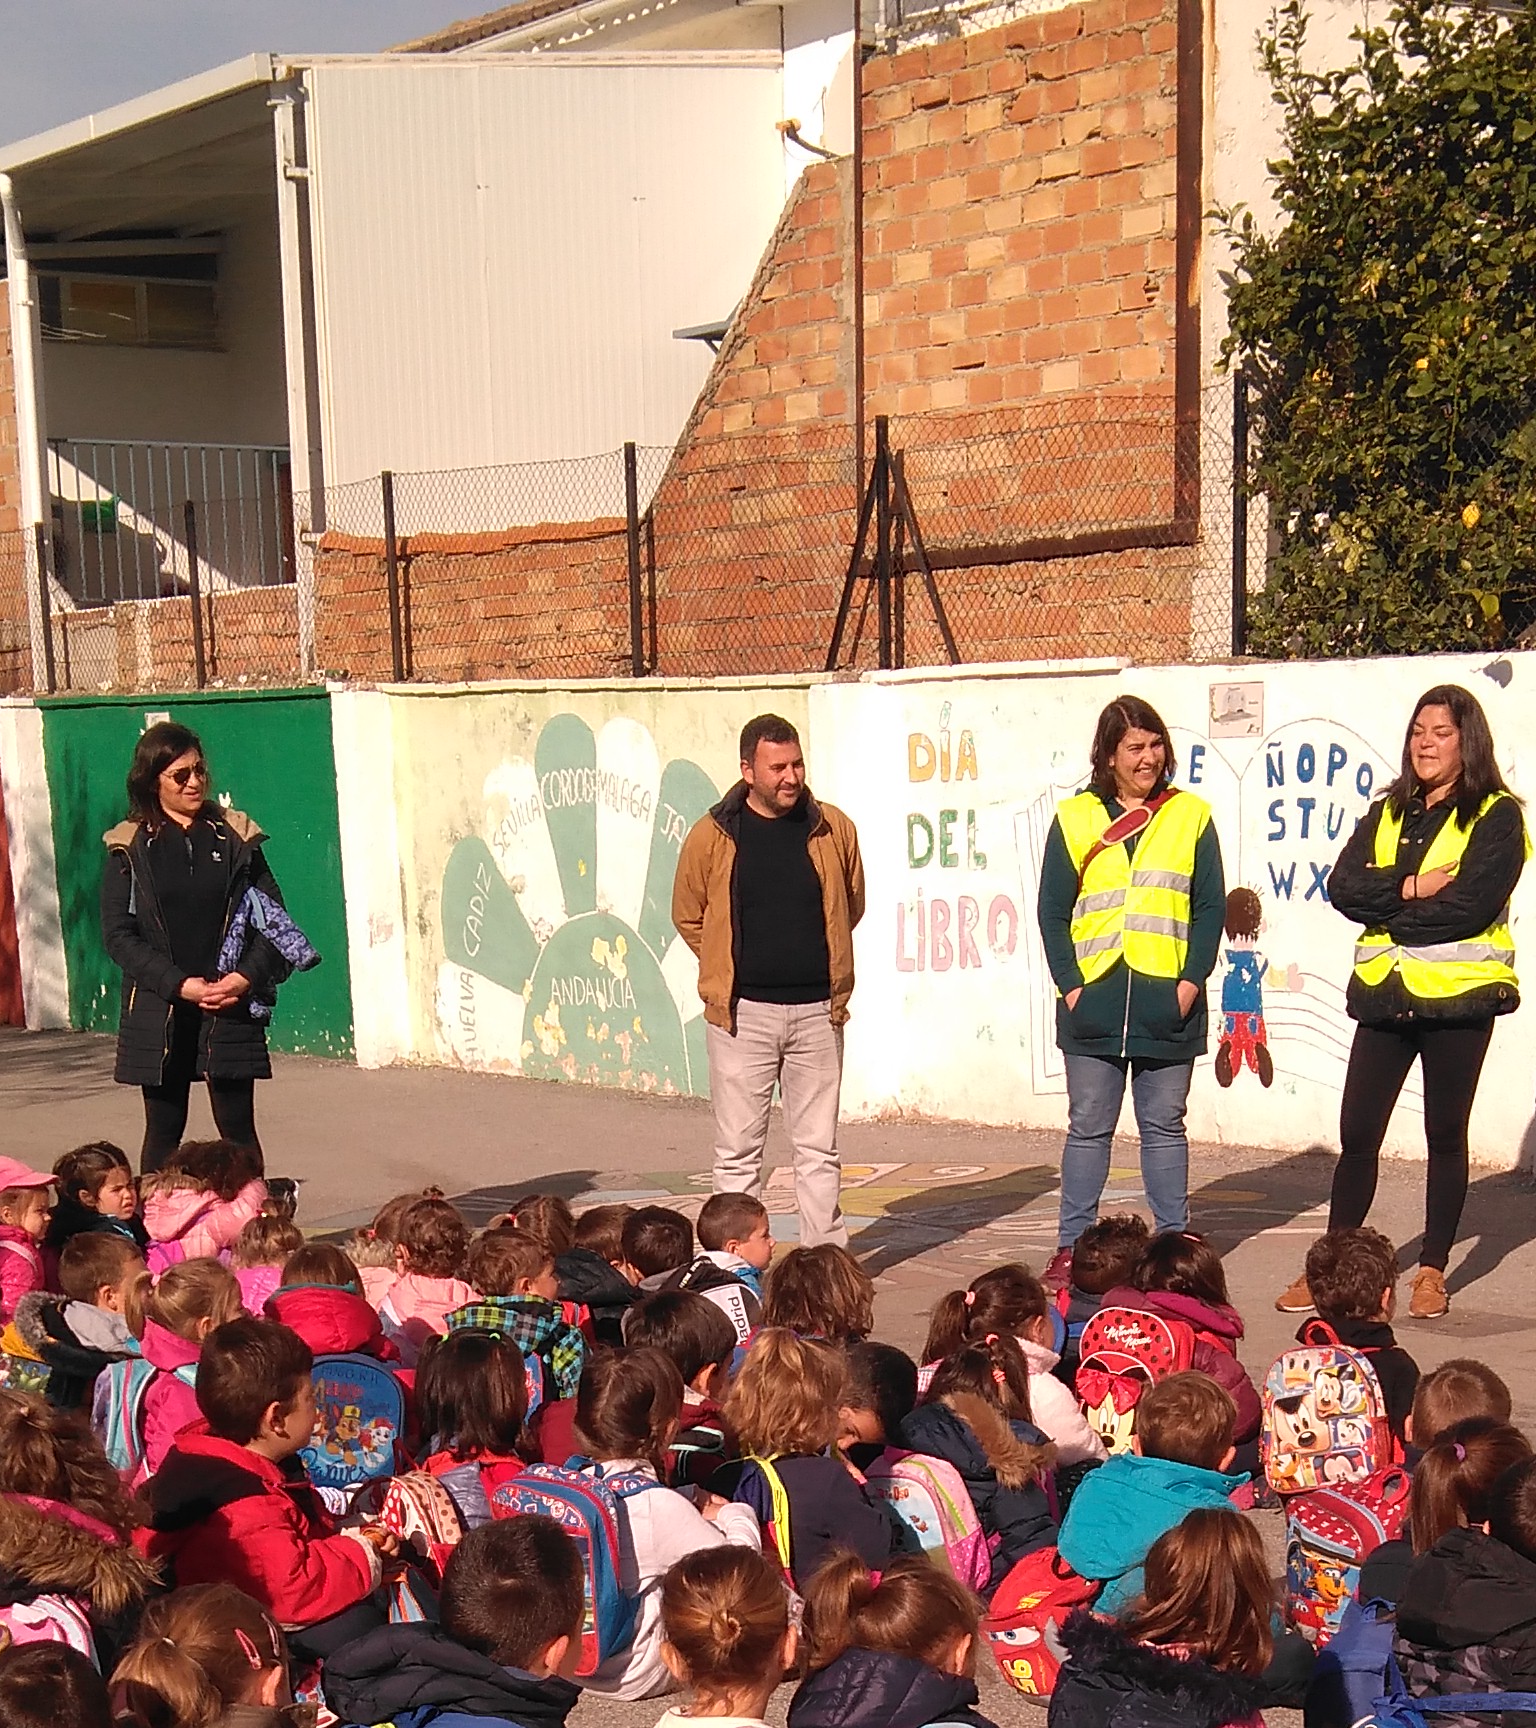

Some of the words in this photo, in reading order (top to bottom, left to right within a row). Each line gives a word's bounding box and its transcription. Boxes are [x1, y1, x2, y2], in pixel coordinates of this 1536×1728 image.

[907, 700, 978, 782] DÍA
[907, 808, 987, 870] DEL
[463, 862, 492, 957] CADIZ
